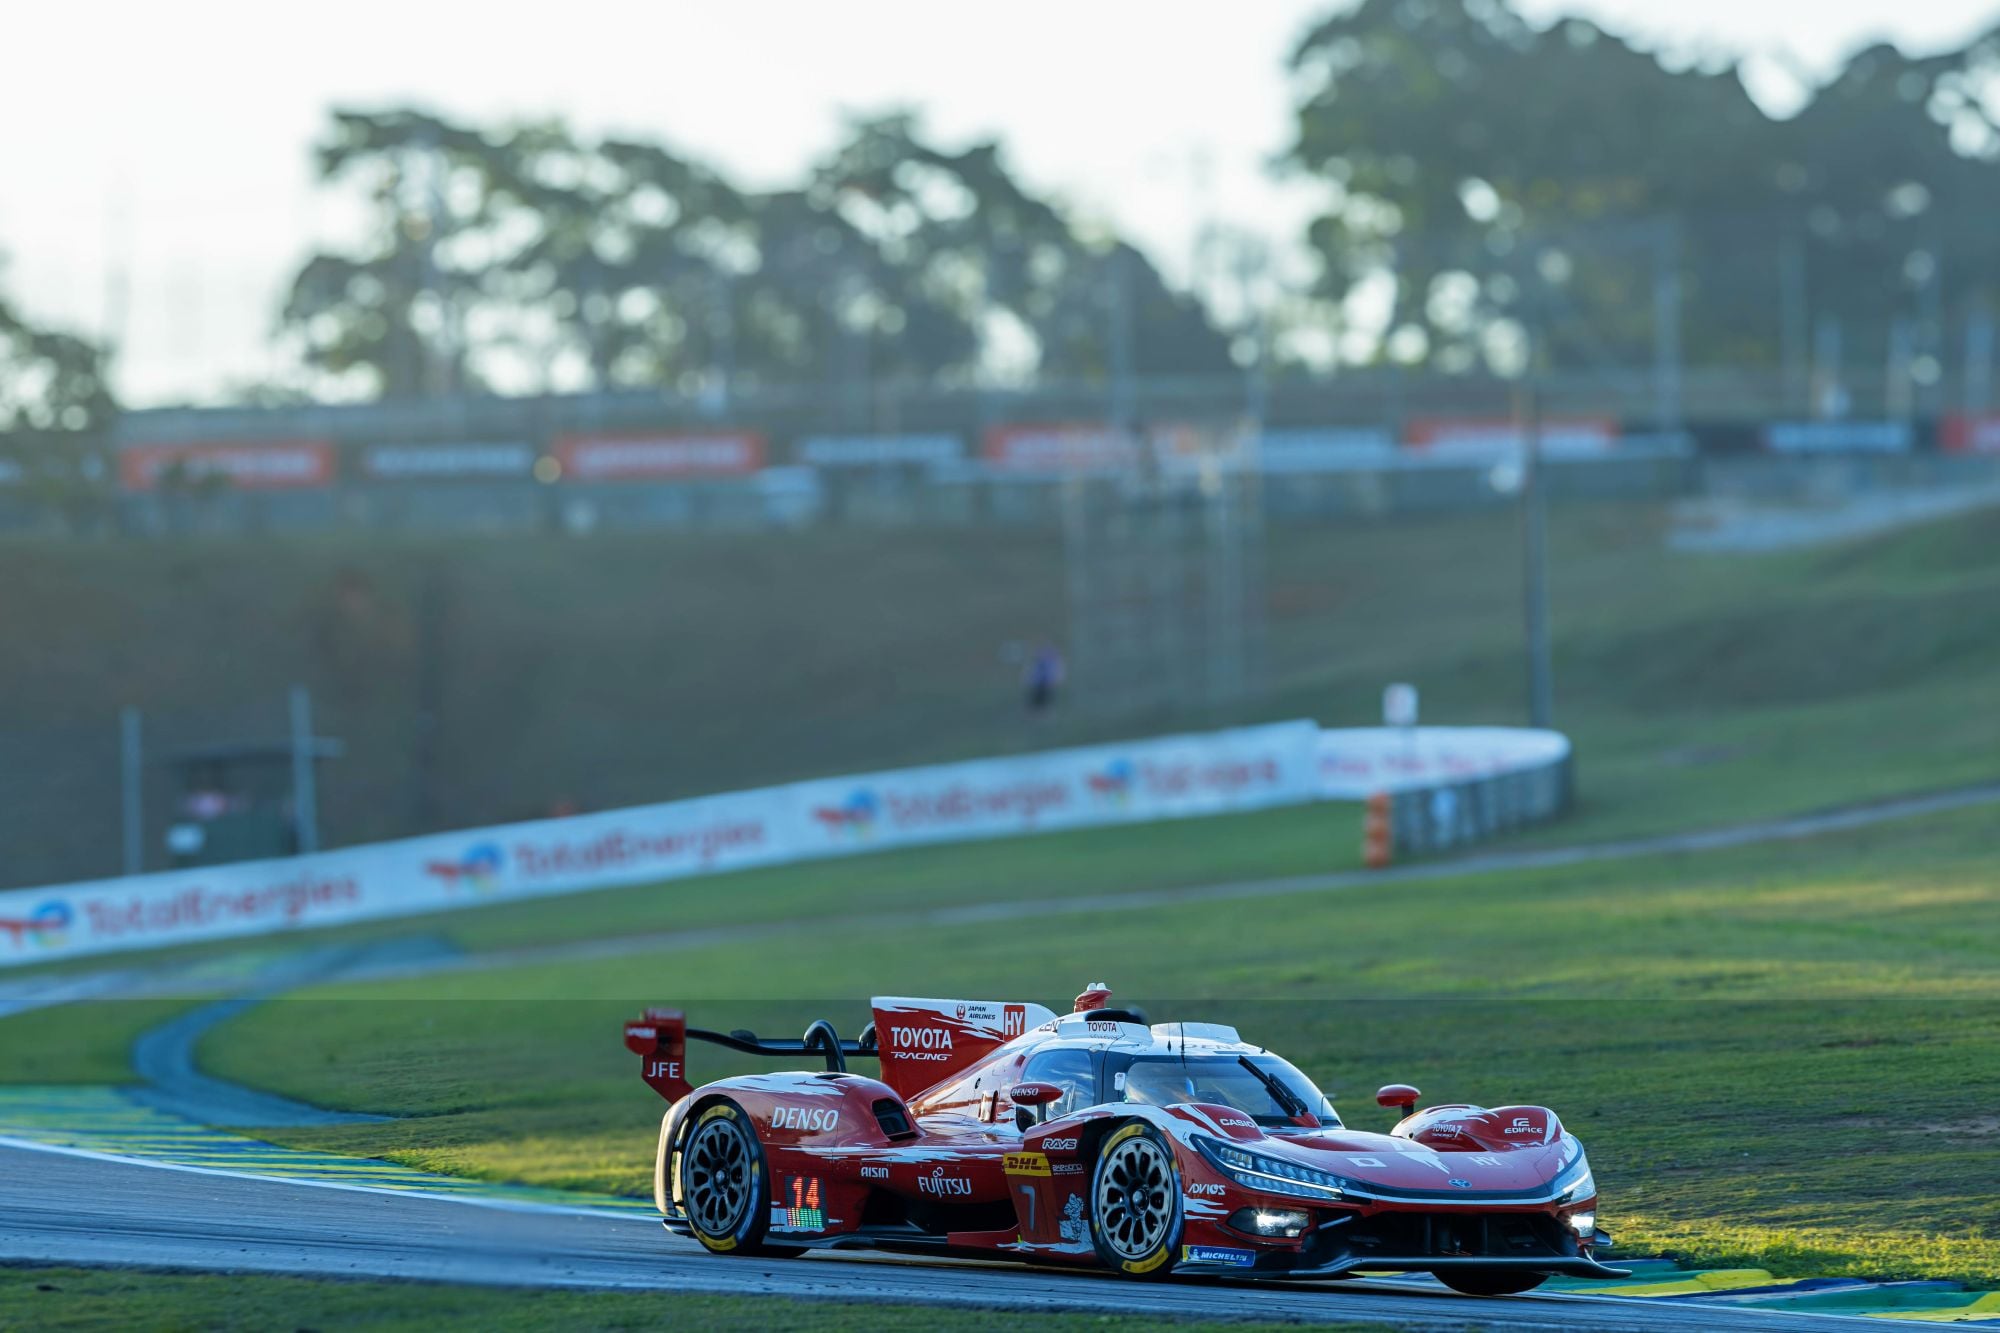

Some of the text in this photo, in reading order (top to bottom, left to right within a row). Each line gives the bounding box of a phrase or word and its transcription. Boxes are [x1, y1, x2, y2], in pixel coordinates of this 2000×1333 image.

[514, 820, 767, 876] TotalEnergies
[87, 873, 360, 938] TotalEnergies
[1005, 1011, 1023, 1036] HY
[1087, 1022, 1117, 1032] TOYOTA
[891, 1026, 952, 1050] TOYOTA
[891, 1052, 952, 1061] RACING
[648, 1061, 680, 1078] JFE
[1011, 1088, 1039, 1097] DENSO
[771, 1106, 839, 1132] DENSO
[1219, 1118, 1255, 1129] CASIO
[1042, 1138, 1077, 1150] RAYS
[861, 1166, 889, 1179] AISIN
[1007, 1157, 1042, 1171] DHL
[917, 1167, 972, 1198] FUJITSU
[792, 1176, 820, 1211] 14
[1018, 1184, 1036, 1233] 7
[1200, 1251, 1248, 1262] MICHELIN
